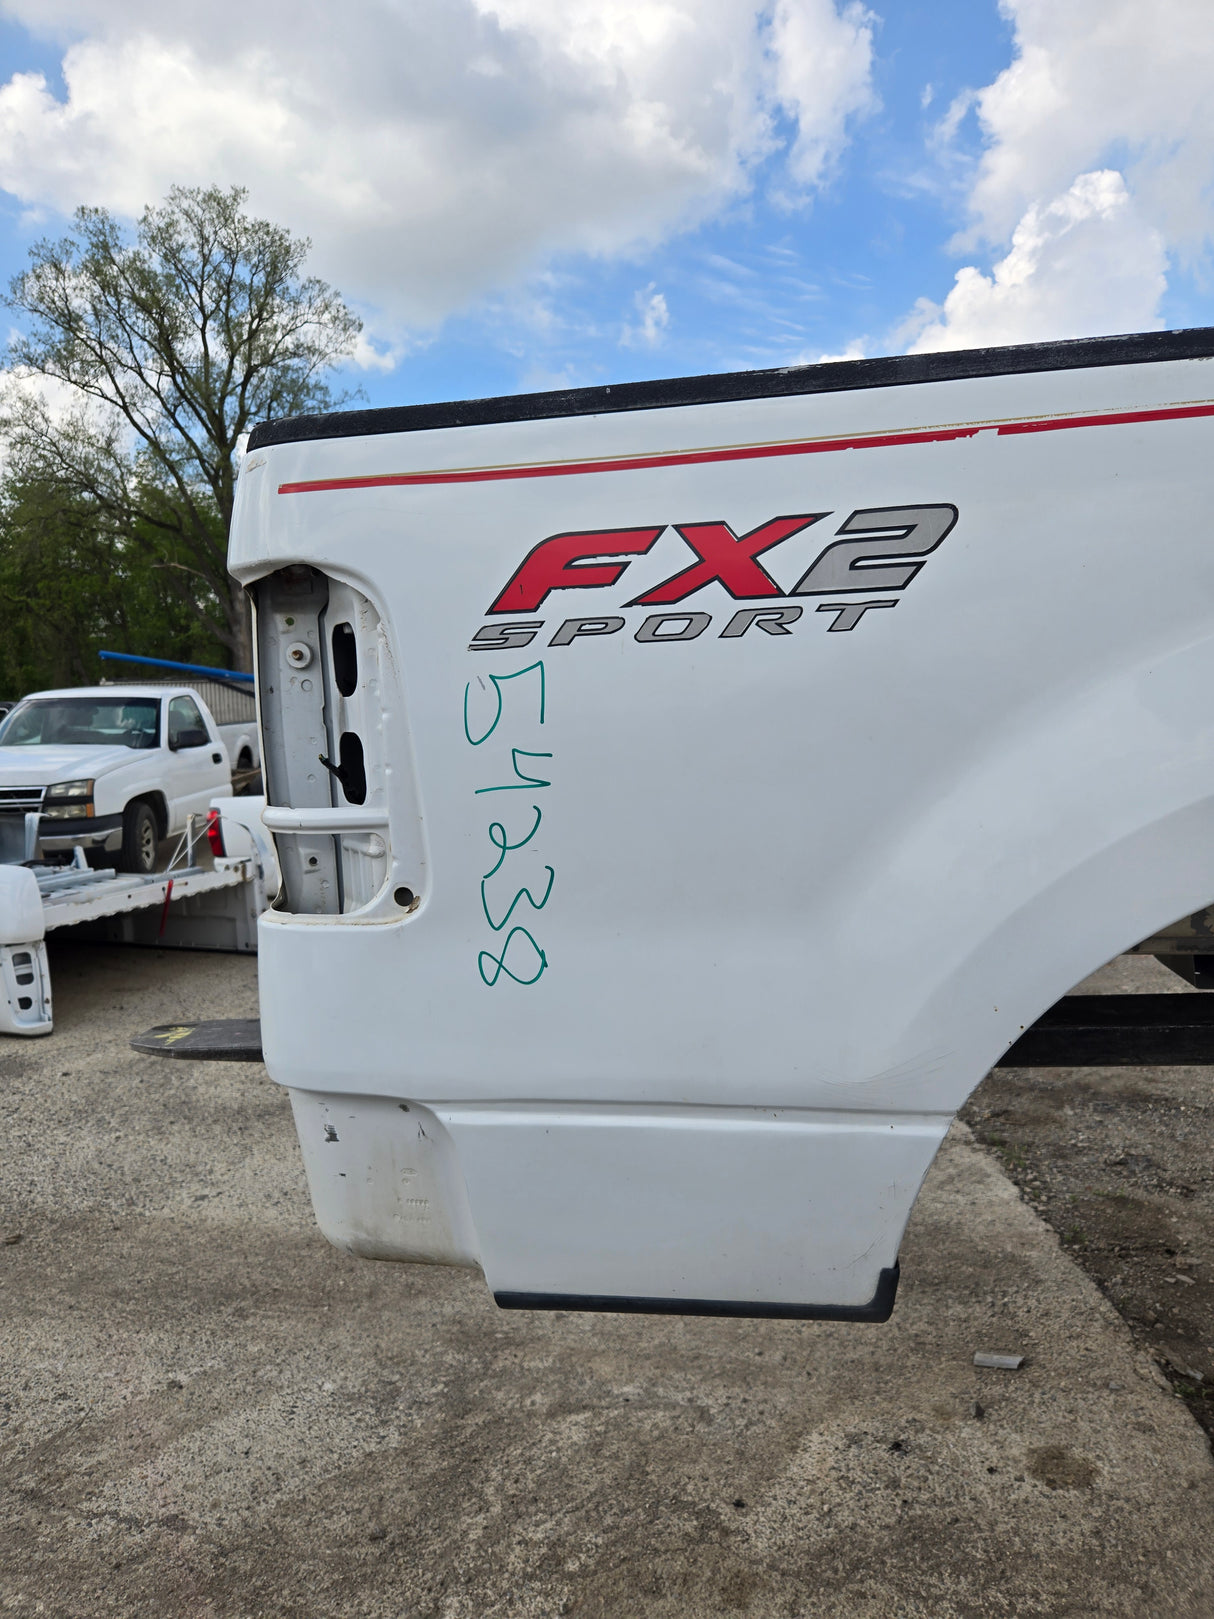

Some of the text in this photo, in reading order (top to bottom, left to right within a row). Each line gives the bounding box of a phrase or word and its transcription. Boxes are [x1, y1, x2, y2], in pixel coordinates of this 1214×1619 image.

[485, 503, 959, 615] FX2
[467, 598, 900, 651] SPORT
[464, 660, 554, 986] 54238
